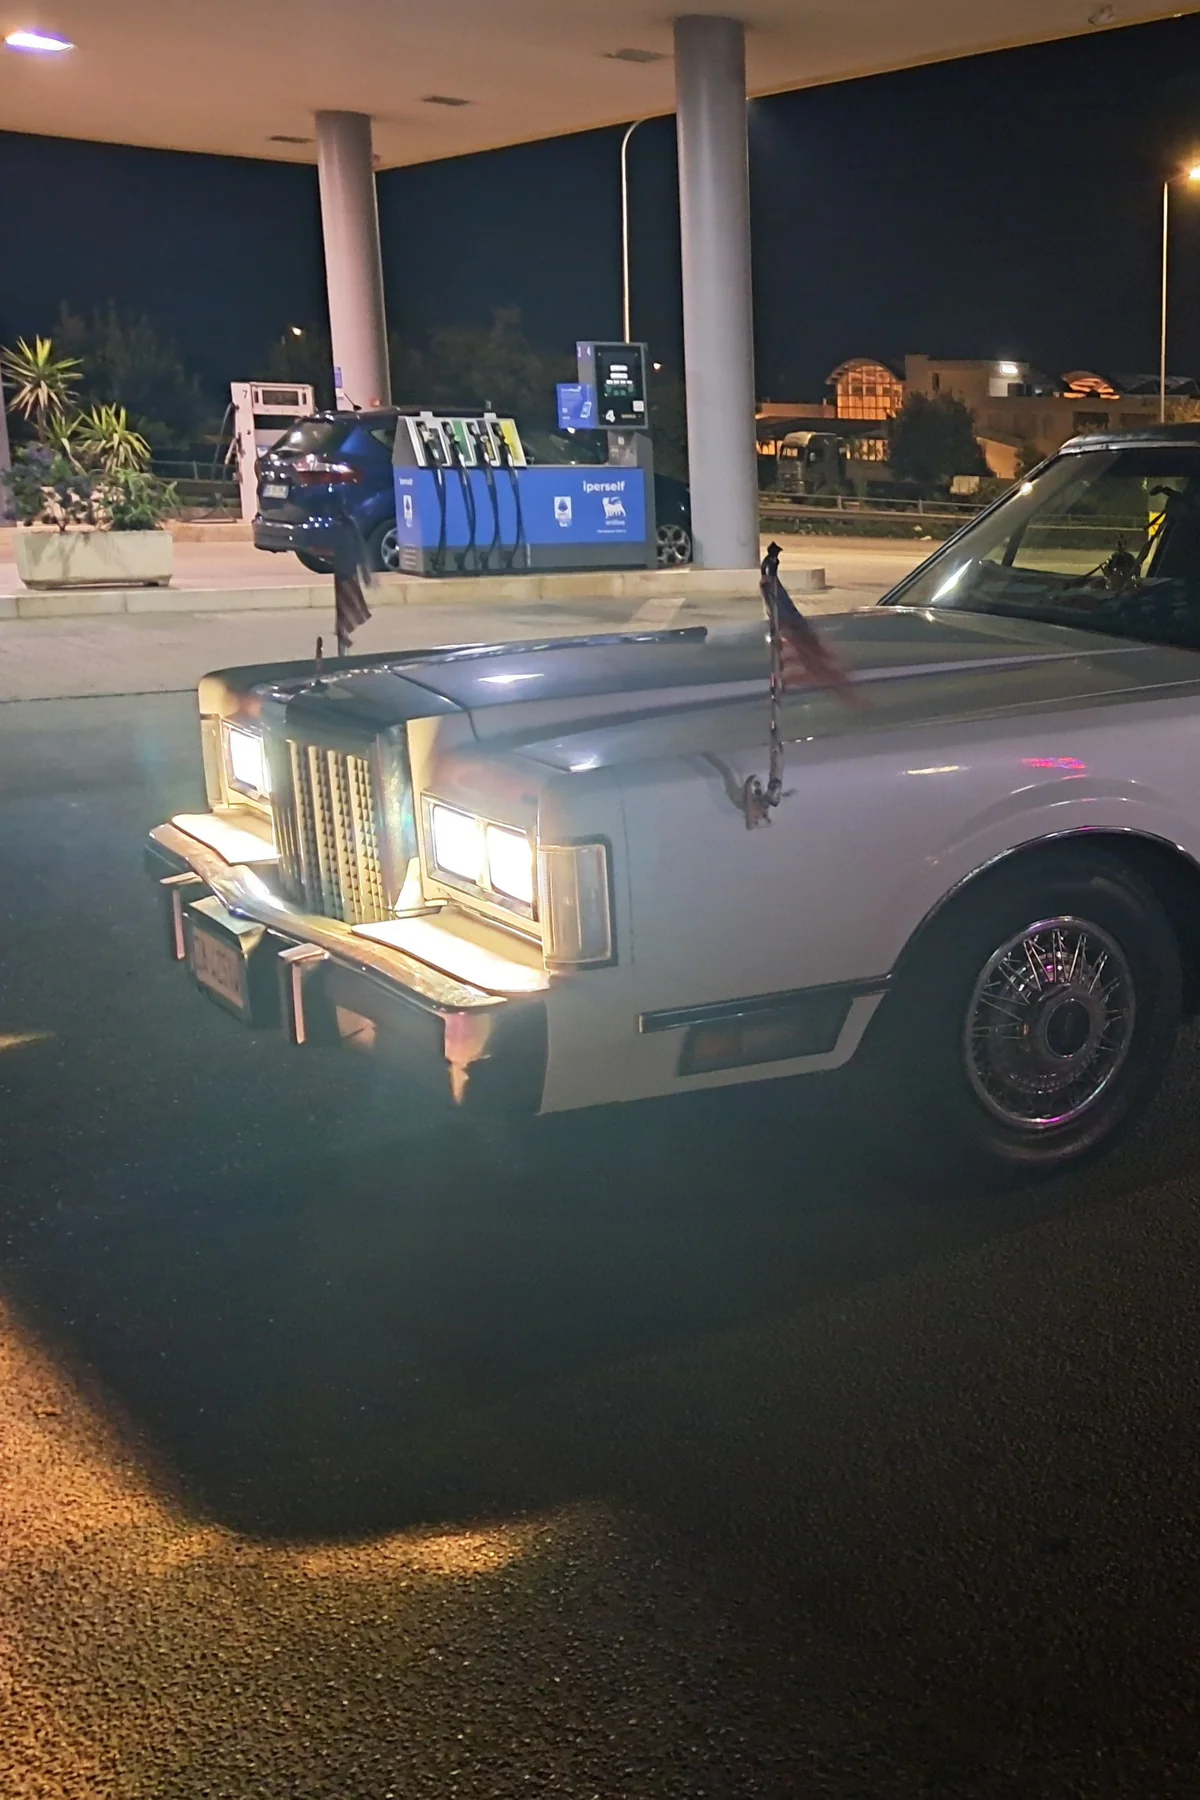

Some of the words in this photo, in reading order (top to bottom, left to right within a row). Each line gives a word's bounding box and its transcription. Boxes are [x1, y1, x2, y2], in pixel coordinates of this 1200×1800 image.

[242, 389, 248, 399] 7
[605, 409, 616, 423] 4
[583, 480, 625, 493] iperself
